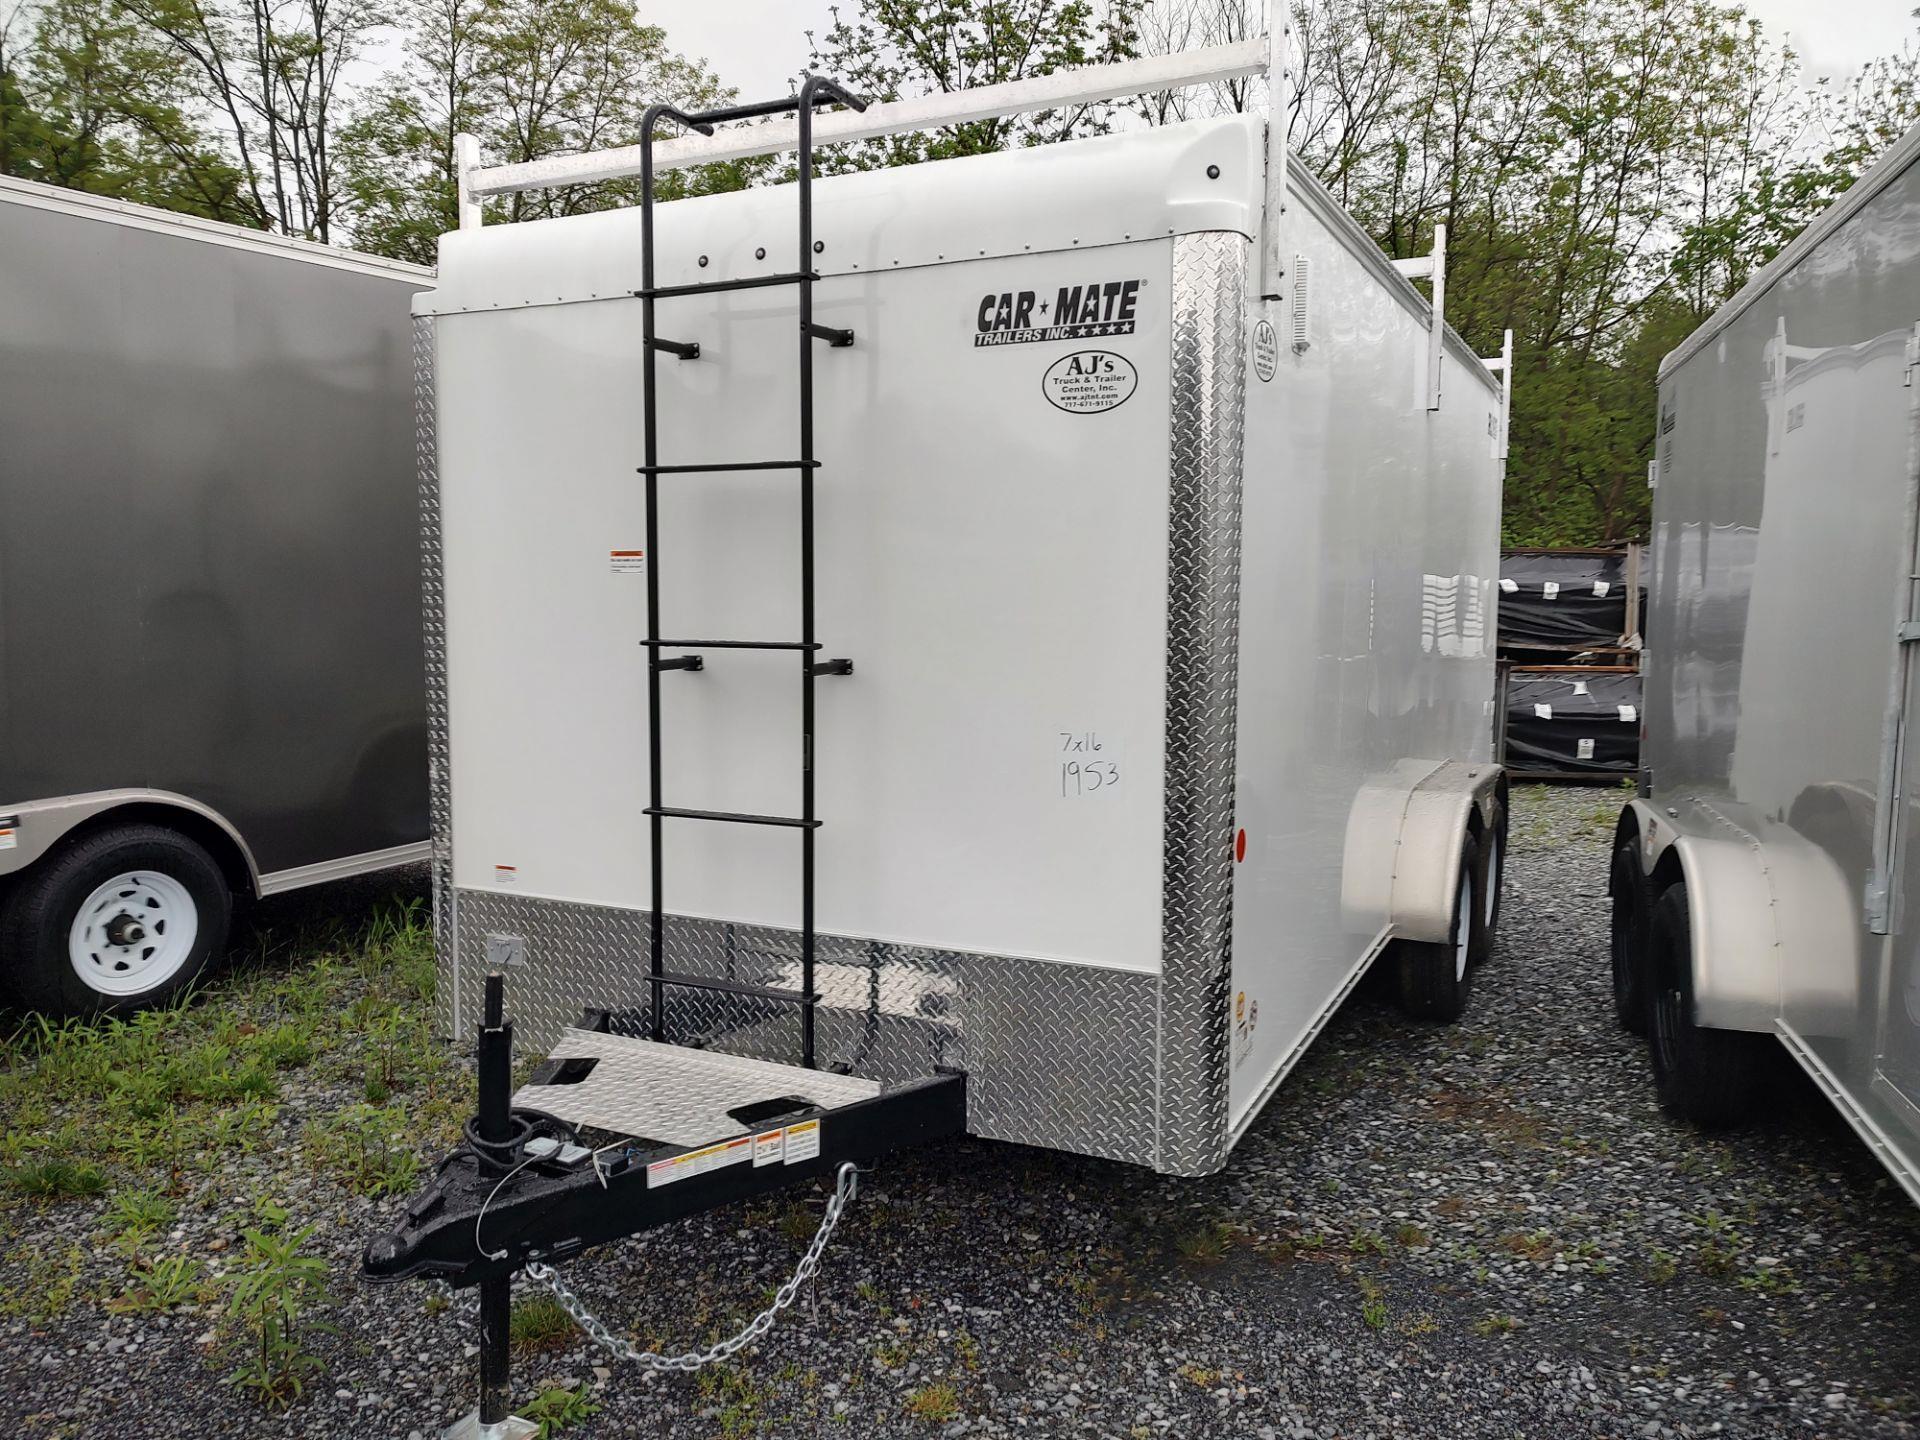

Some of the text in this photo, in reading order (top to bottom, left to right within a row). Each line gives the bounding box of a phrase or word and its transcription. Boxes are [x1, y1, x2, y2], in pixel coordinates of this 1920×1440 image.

[977, 279, 1140, 332] CAR MATE
[976, 327, 1073, 345] TRAILERS INC.
[1065, 355, 1114, 376] AJ's
[1053, 377, 1080, 385] Truck
[1094, 375, 1126, 383] Trailer
[1060, 732, 1102, 752] 7x16
[1062, 761, 1119, 797] 1953
